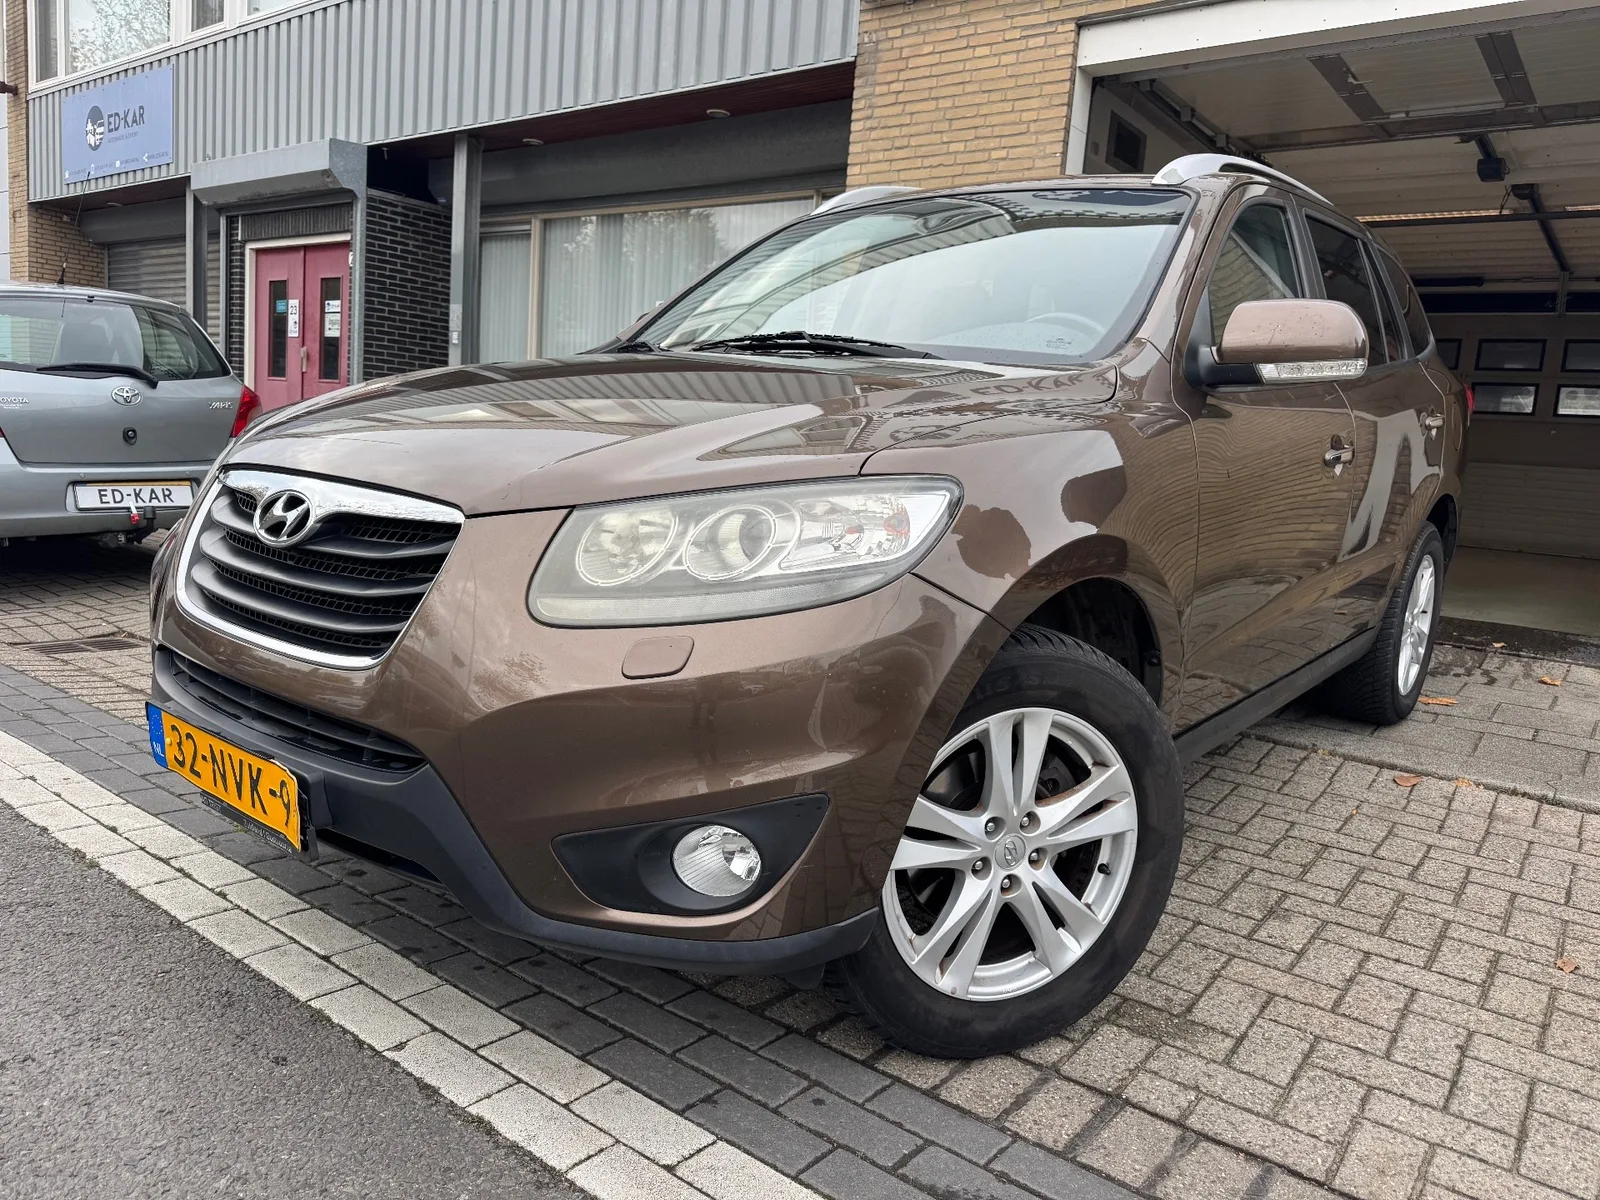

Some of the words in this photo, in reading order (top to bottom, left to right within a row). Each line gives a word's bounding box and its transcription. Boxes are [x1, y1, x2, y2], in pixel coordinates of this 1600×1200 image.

[107, 105, 145, 133] ED-KAR
[289, 305, 298, 315] 23
[0, 396, 29, 404] OYOTA
[98, 487, 175, 504] ED-KAR
[152, 741, 165, 757] NL
[170, 724, 292, 828] 32-NVK-9
